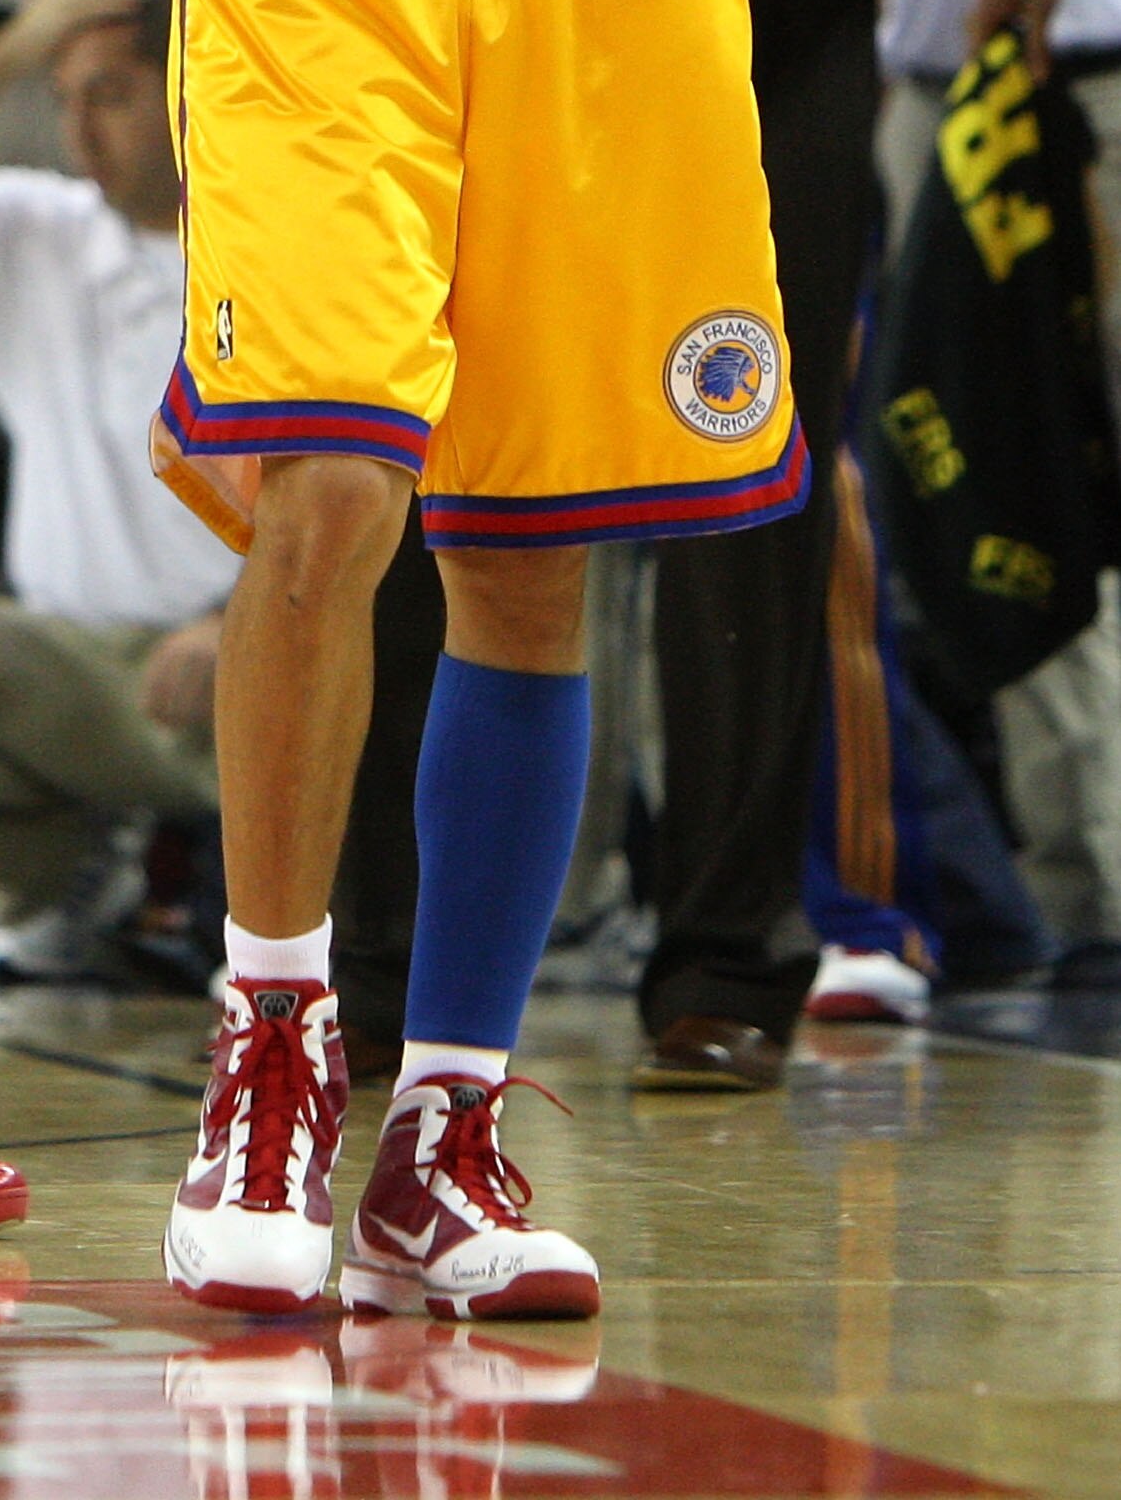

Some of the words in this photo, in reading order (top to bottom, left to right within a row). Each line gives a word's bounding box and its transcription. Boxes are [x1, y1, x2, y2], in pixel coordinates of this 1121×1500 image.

[677, 338, 704, 377] SAN
[702, 321, 774, 375] FRANCISCO
[685, 397, 767, 432] WARRIORS
